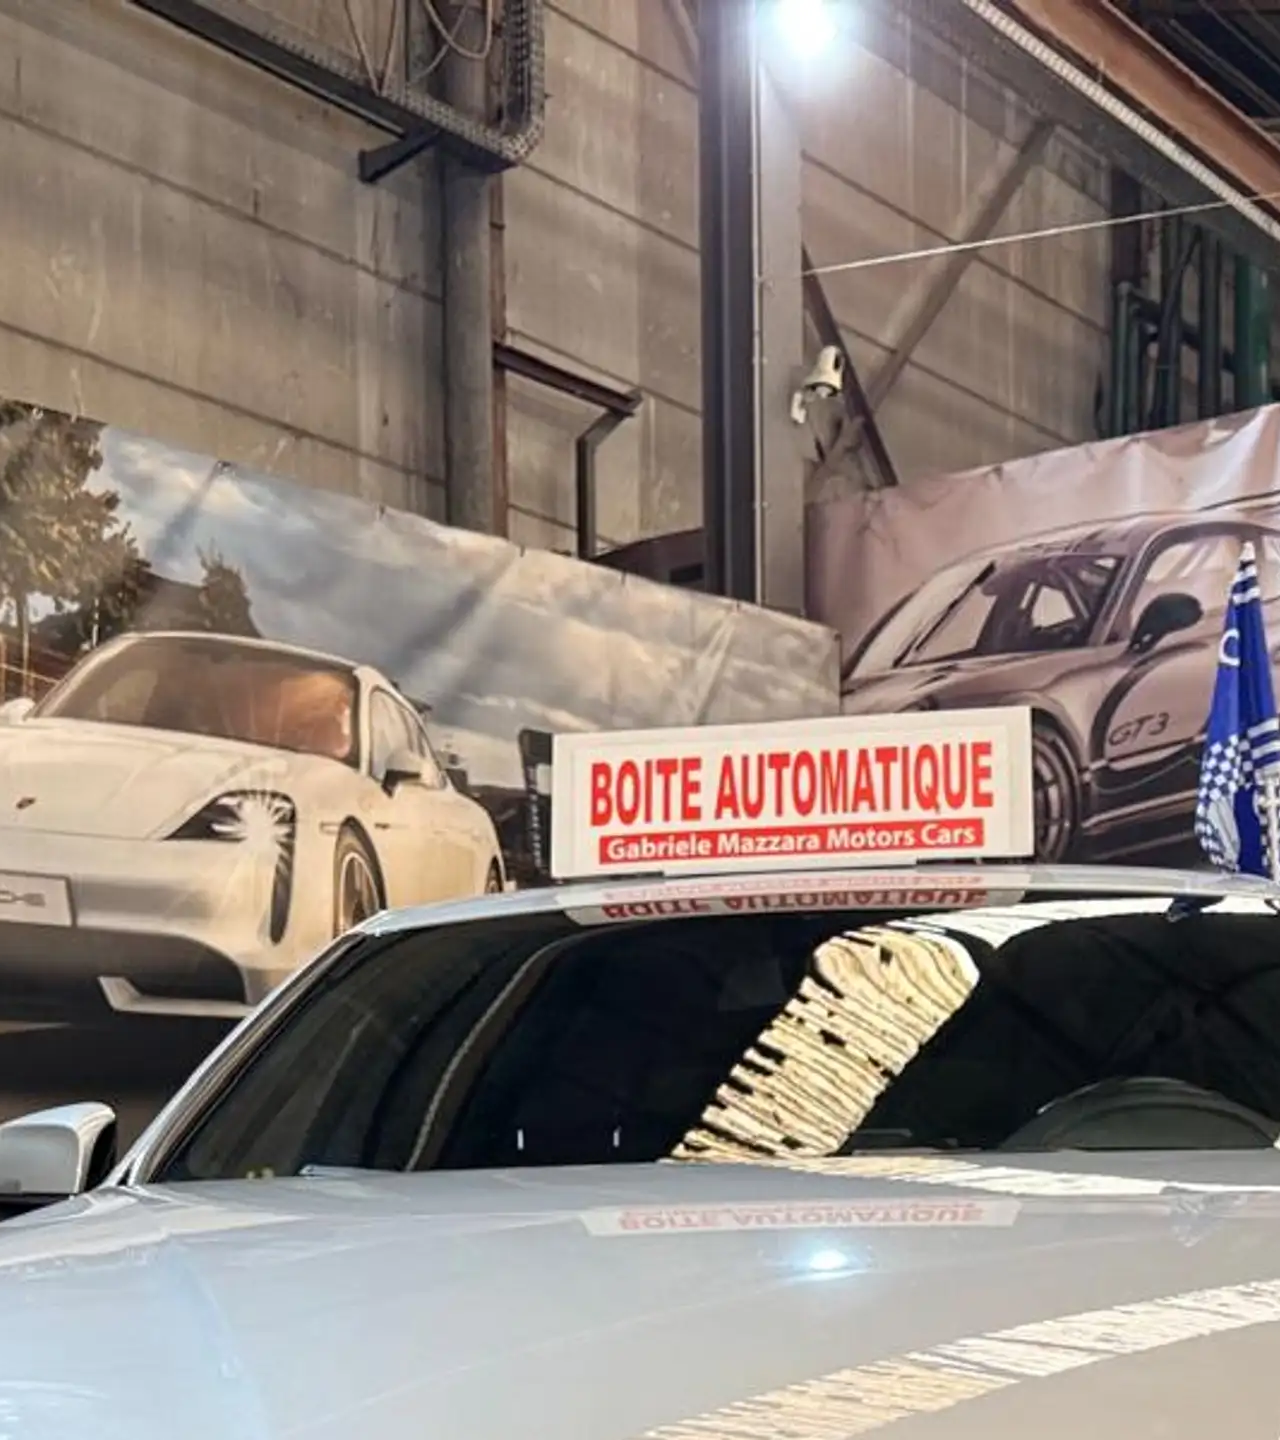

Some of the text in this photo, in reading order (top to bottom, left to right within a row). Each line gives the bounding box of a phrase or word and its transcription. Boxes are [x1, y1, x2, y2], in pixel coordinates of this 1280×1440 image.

[1108, 712, 1169, 746] GT3
[590, 756, 702, 827] BOITE
[714, 741, 994, 820] AUTOMATIQUE
[607, 823, 975, 861] Gabriele Mazzara Motors Cars
